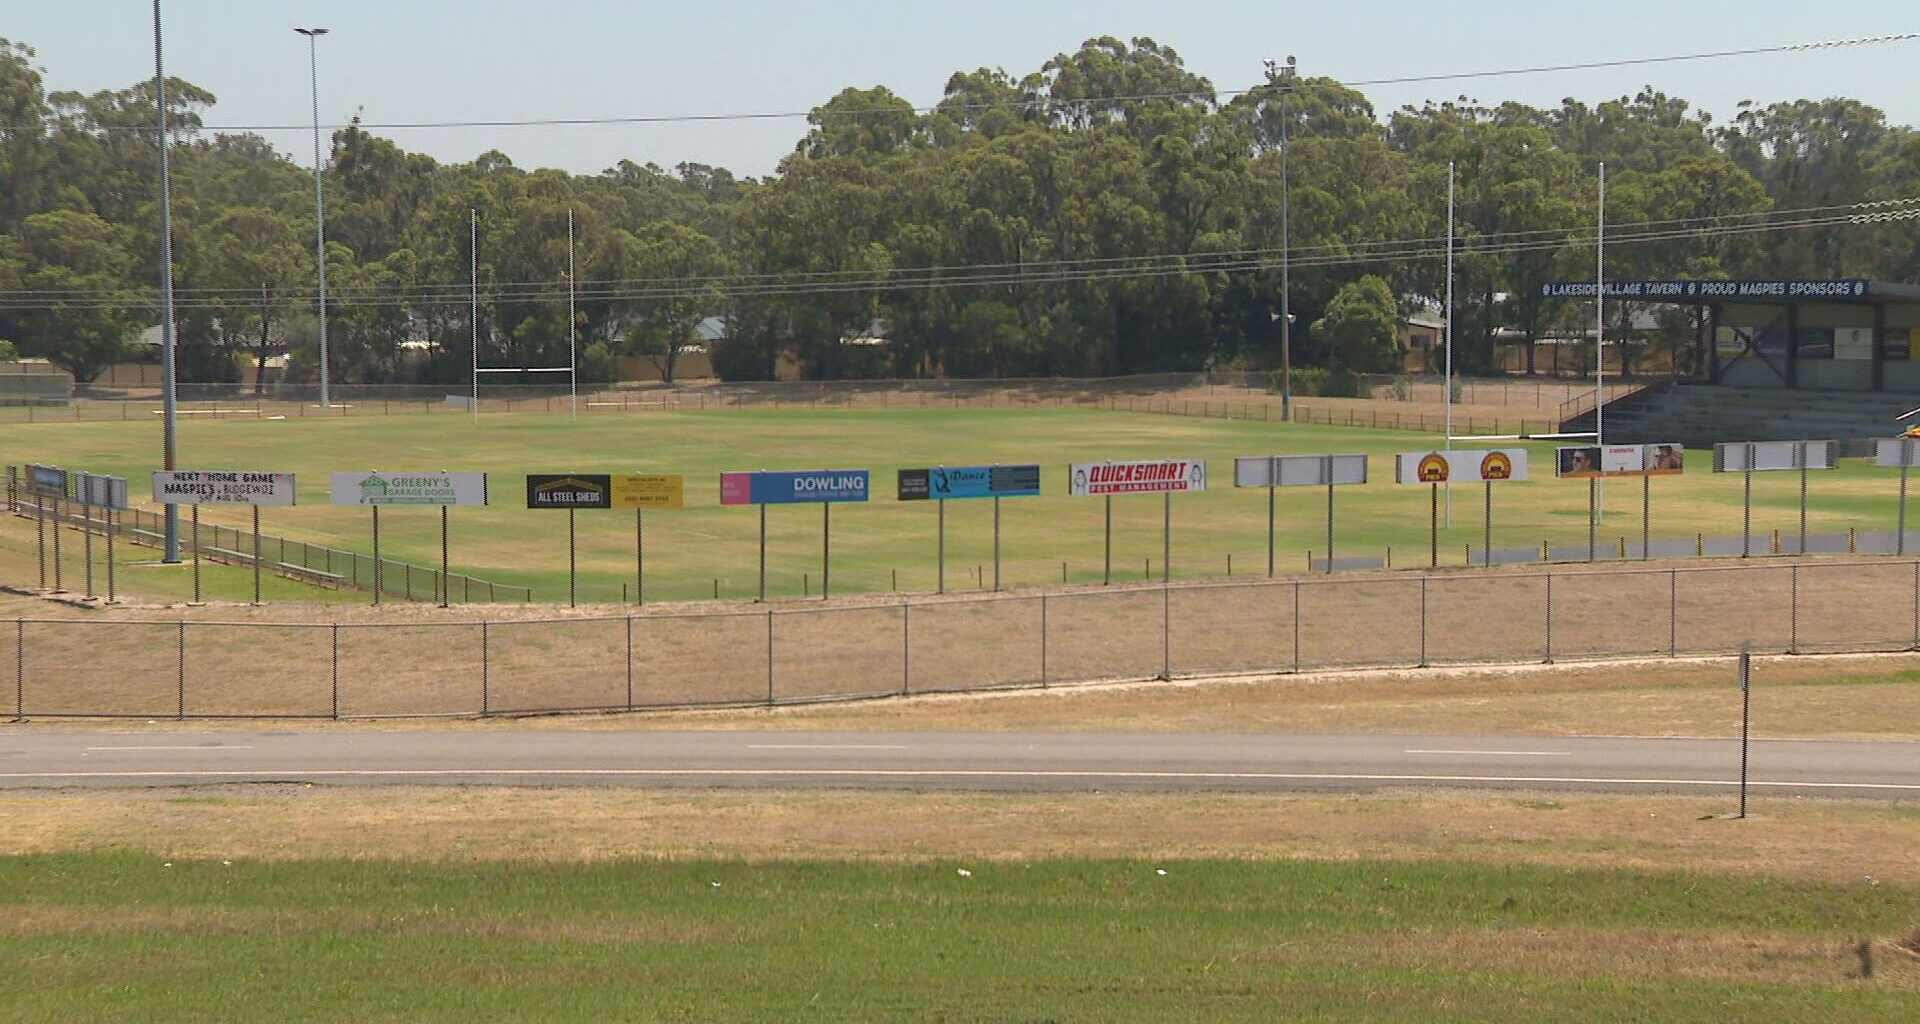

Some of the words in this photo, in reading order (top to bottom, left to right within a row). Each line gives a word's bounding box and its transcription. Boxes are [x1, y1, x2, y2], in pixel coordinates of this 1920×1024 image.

[1551, 283, 1598, 296] LAKESIDE
[1600, 283, 1641, 295] VILLAGE
[1645, 283, 1682, 295] TAVERN
[1701, 282, 1737, 295] PROUD
[1739, 282, 1785, 295] MAGPIES
[1789, 282, 1851, 295] SPONSORS
[174, 472, 200, 482] NEXT
[1090, 462, 1187, 483] QUICKSMART
[392, 477, 450, 487] GREENY'S
[794, 476, 864, 490] DOWLING
[1091, 484, 1114, 493] PEST
[1119, 482, 1187, 492] MANAGEMENT
[388, 488, 422, 496] GARAGE
[425, 488, 456, 496] DOORS
[537, 491, 551, 502] ALL
[553, 491, 575, 502] STEEL
[576, 491, 601, 502] SHEDS
